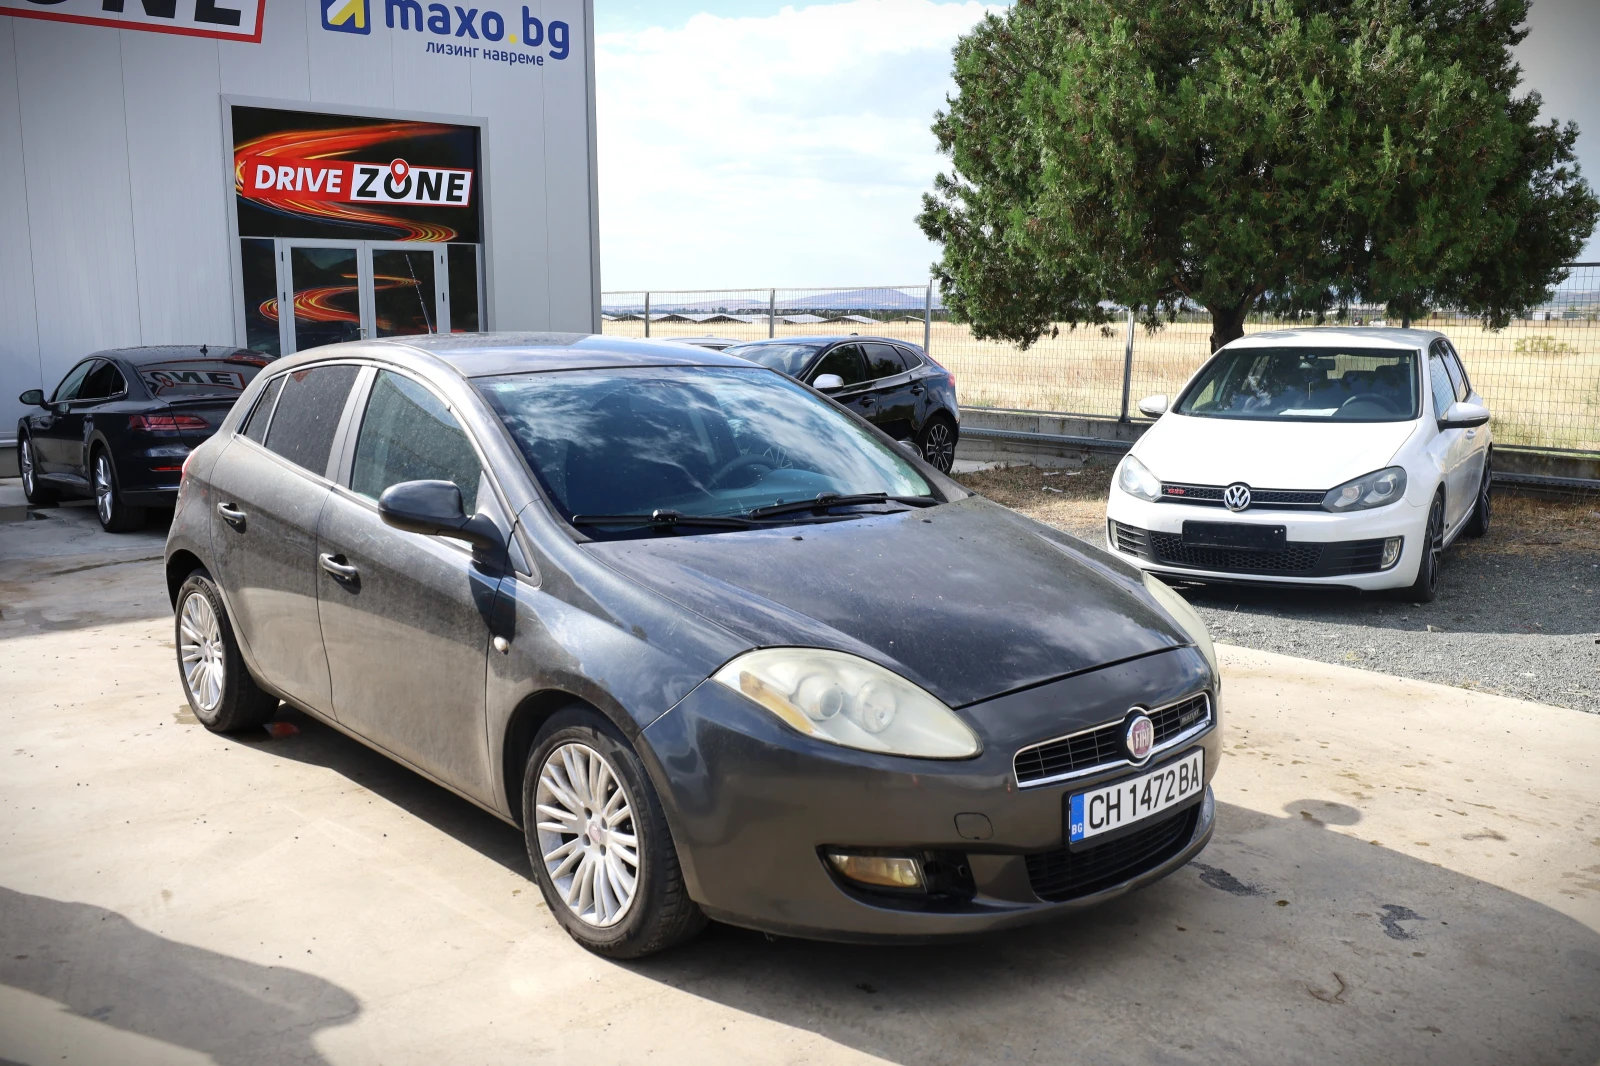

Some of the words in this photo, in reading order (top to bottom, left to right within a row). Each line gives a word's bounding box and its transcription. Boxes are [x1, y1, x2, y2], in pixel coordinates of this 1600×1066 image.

[385, 0, 570, 60] maxo.bg
[425, 41, 480, 58] лизинг
[483, 48, 544, 66] навреме
[254, 164, 343, 193] DRIVE
[356, 167, 466, 203] ZONE
[1089, 788, 1121, 830] CH
[1129, 769, 1176, 817] 1472
[1179, 757, 1200, 796] BA
[1071, 822, 1083, 835] BG
